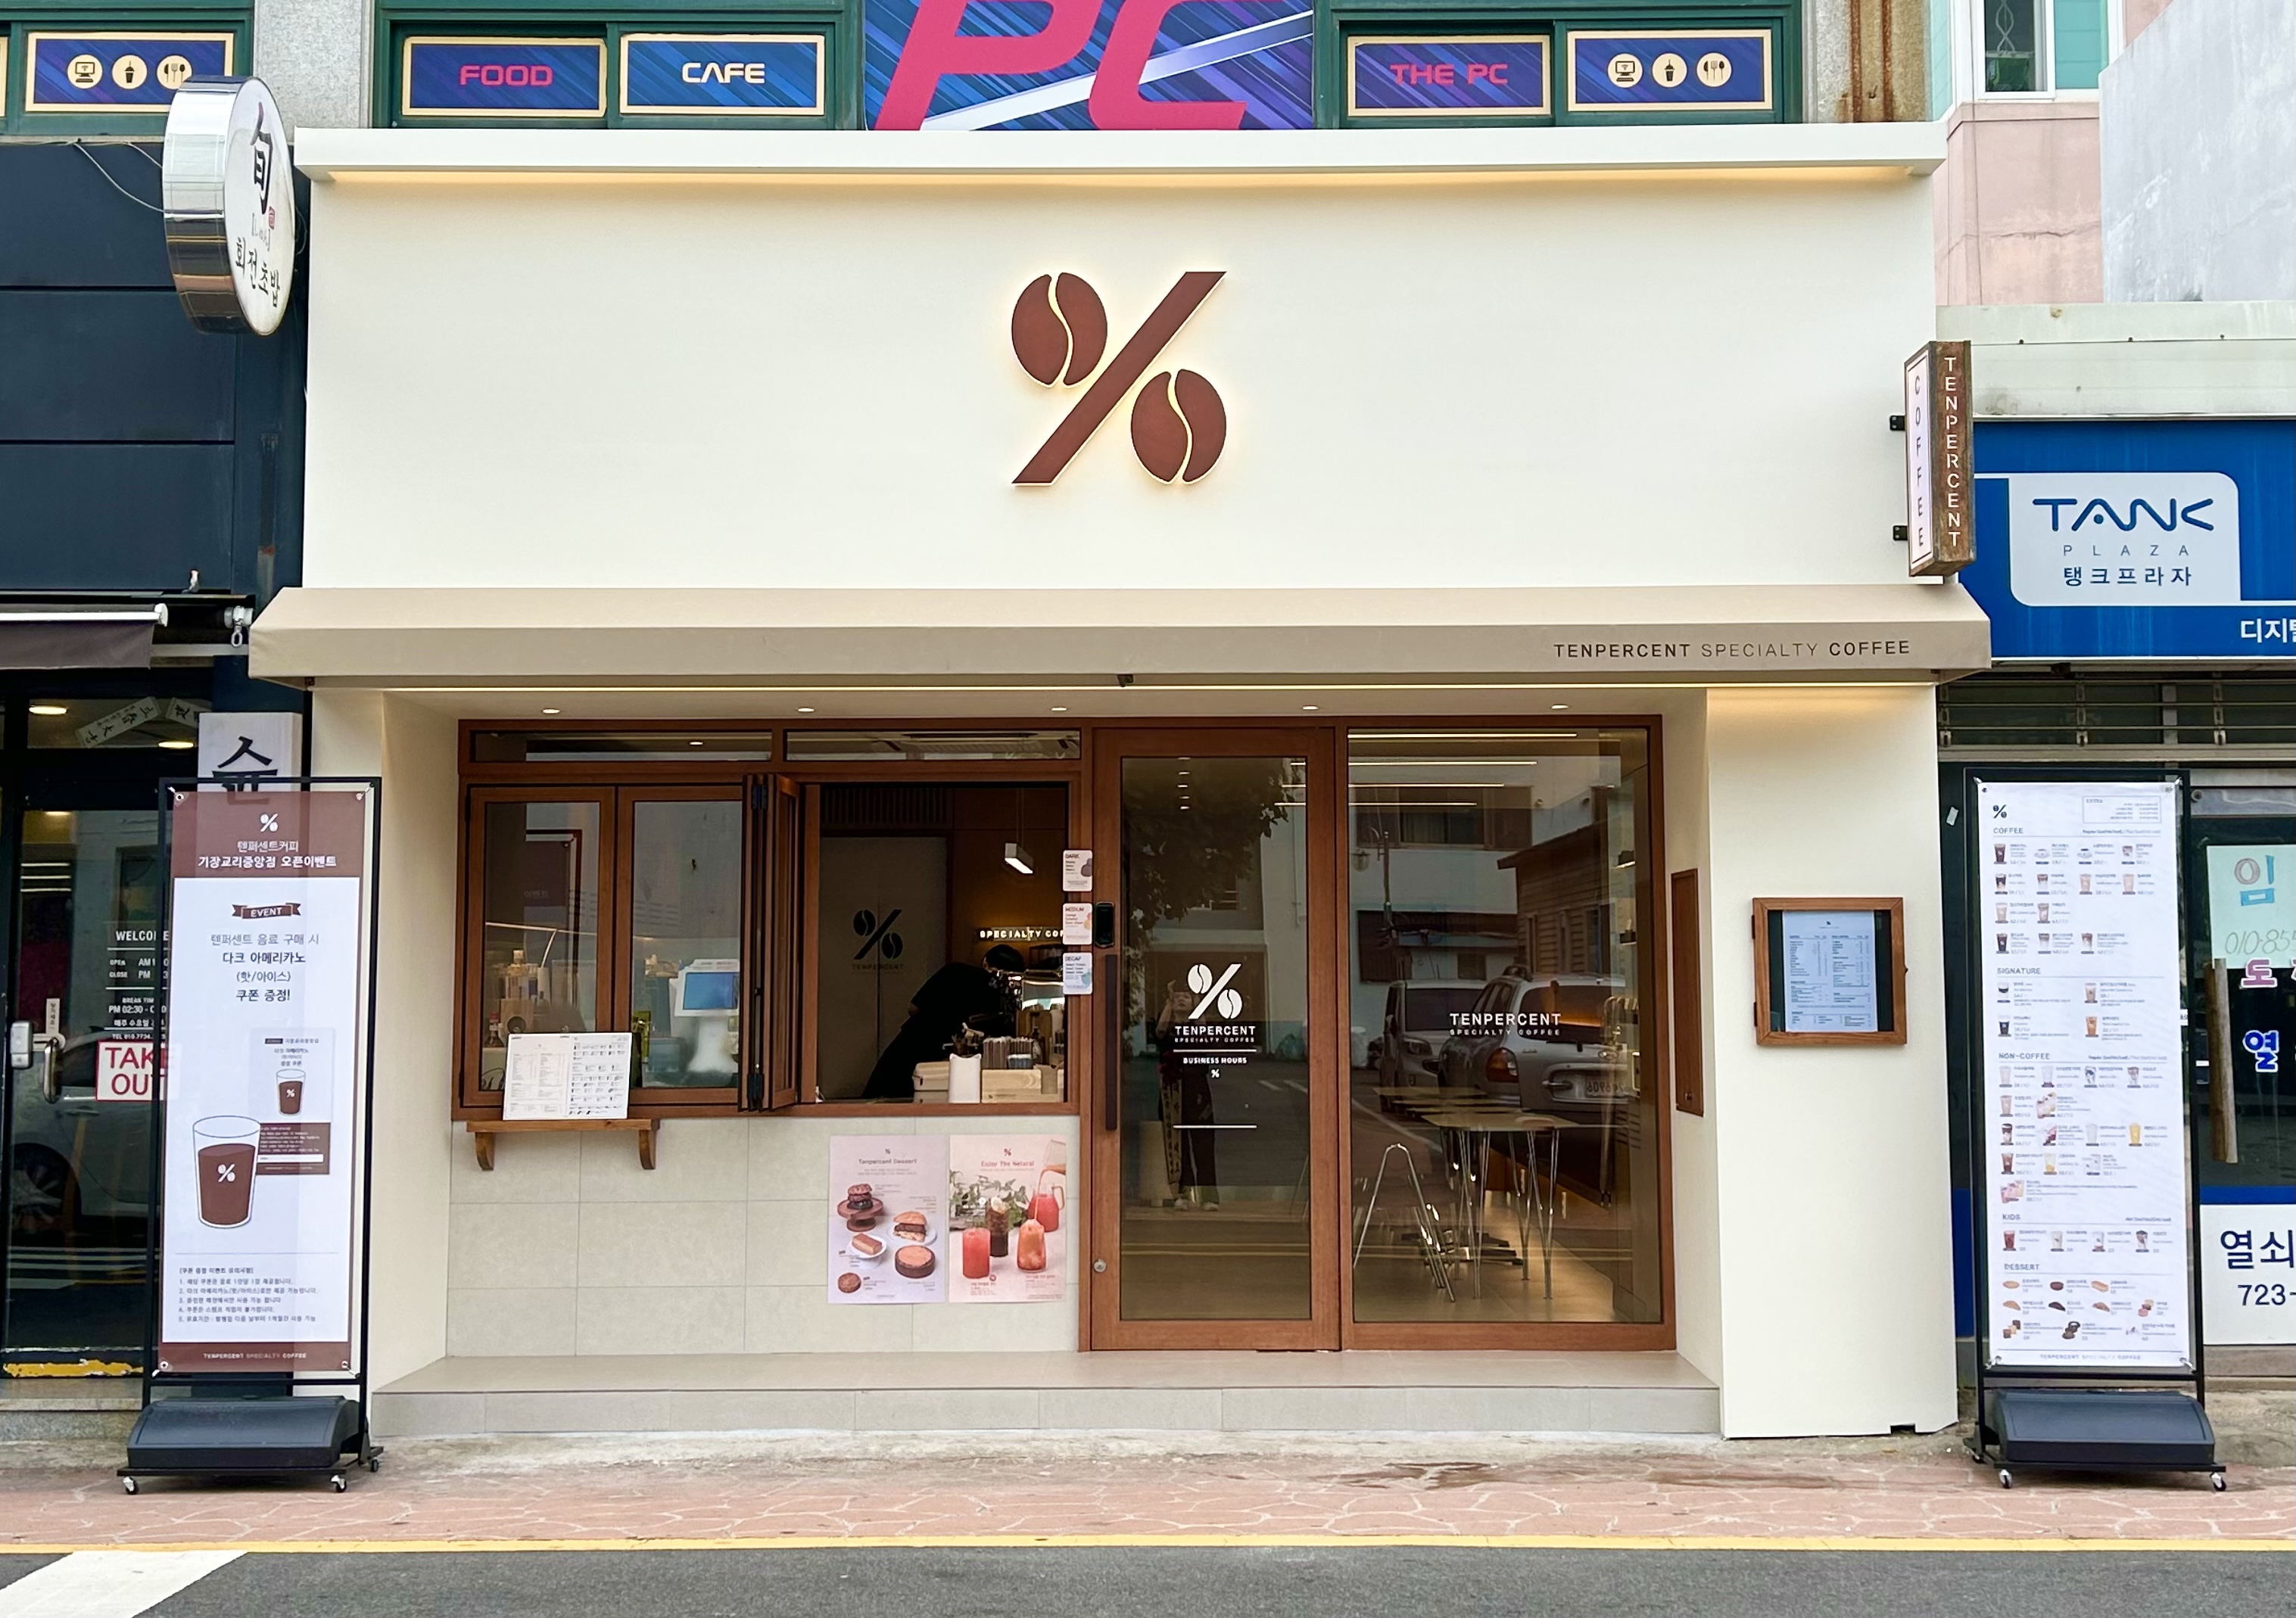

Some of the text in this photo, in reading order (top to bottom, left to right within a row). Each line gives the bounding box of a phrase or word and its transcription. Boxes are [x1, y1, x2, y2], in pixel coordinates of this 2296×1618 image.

[460, 65, 553, 86] FOOD
[682, 63, 765, 84] CAFE
[1390, 63, 1509, 86] THE PC
[235, 236, 281, 307] 회전초밥
[1944, 356, 1961, 547] TENPERCENT
[1914, 375, 1924, 548] COFFEE
[2032, 497, 2214, 532] TANK
[2063, 544, 2189, 557] PLAZA
[2064, 566, 2192, 587] 탱크프라자
[1553, 640, 1911, 658] TENPERCENT SPECIALTY COFFEE
[237, 840, 299, 853] 텐퍼센트커피
[198, 855, 337, 869] 기장교리중앙점 오픈이벤트
[250, 907, 283, 918] EVENT
[116, 930, 169, 941] WELCOE
[210, 933, 319, 946] 텐퍼센트 음료 구매 시
[980, 929, 1042, 938] SPECIALTY
[138, 958, 151, 966] AM
[223, 951, 306, 964] 다크 아메리카노
[236, 971, 291, 983] (핫/아이스)
[235, 989, 291, 1002] 쿠폰 증정!
[1450, 1013, 1562, 1026] TENPERCENT
[1174, 1025, 1257, 1036] TENPERCENT
[105, 1047, 166, 1069] TAK
[111, 1074, 165, 1095] OU
[2220, 1230, 2294, 1269] 열쇠
